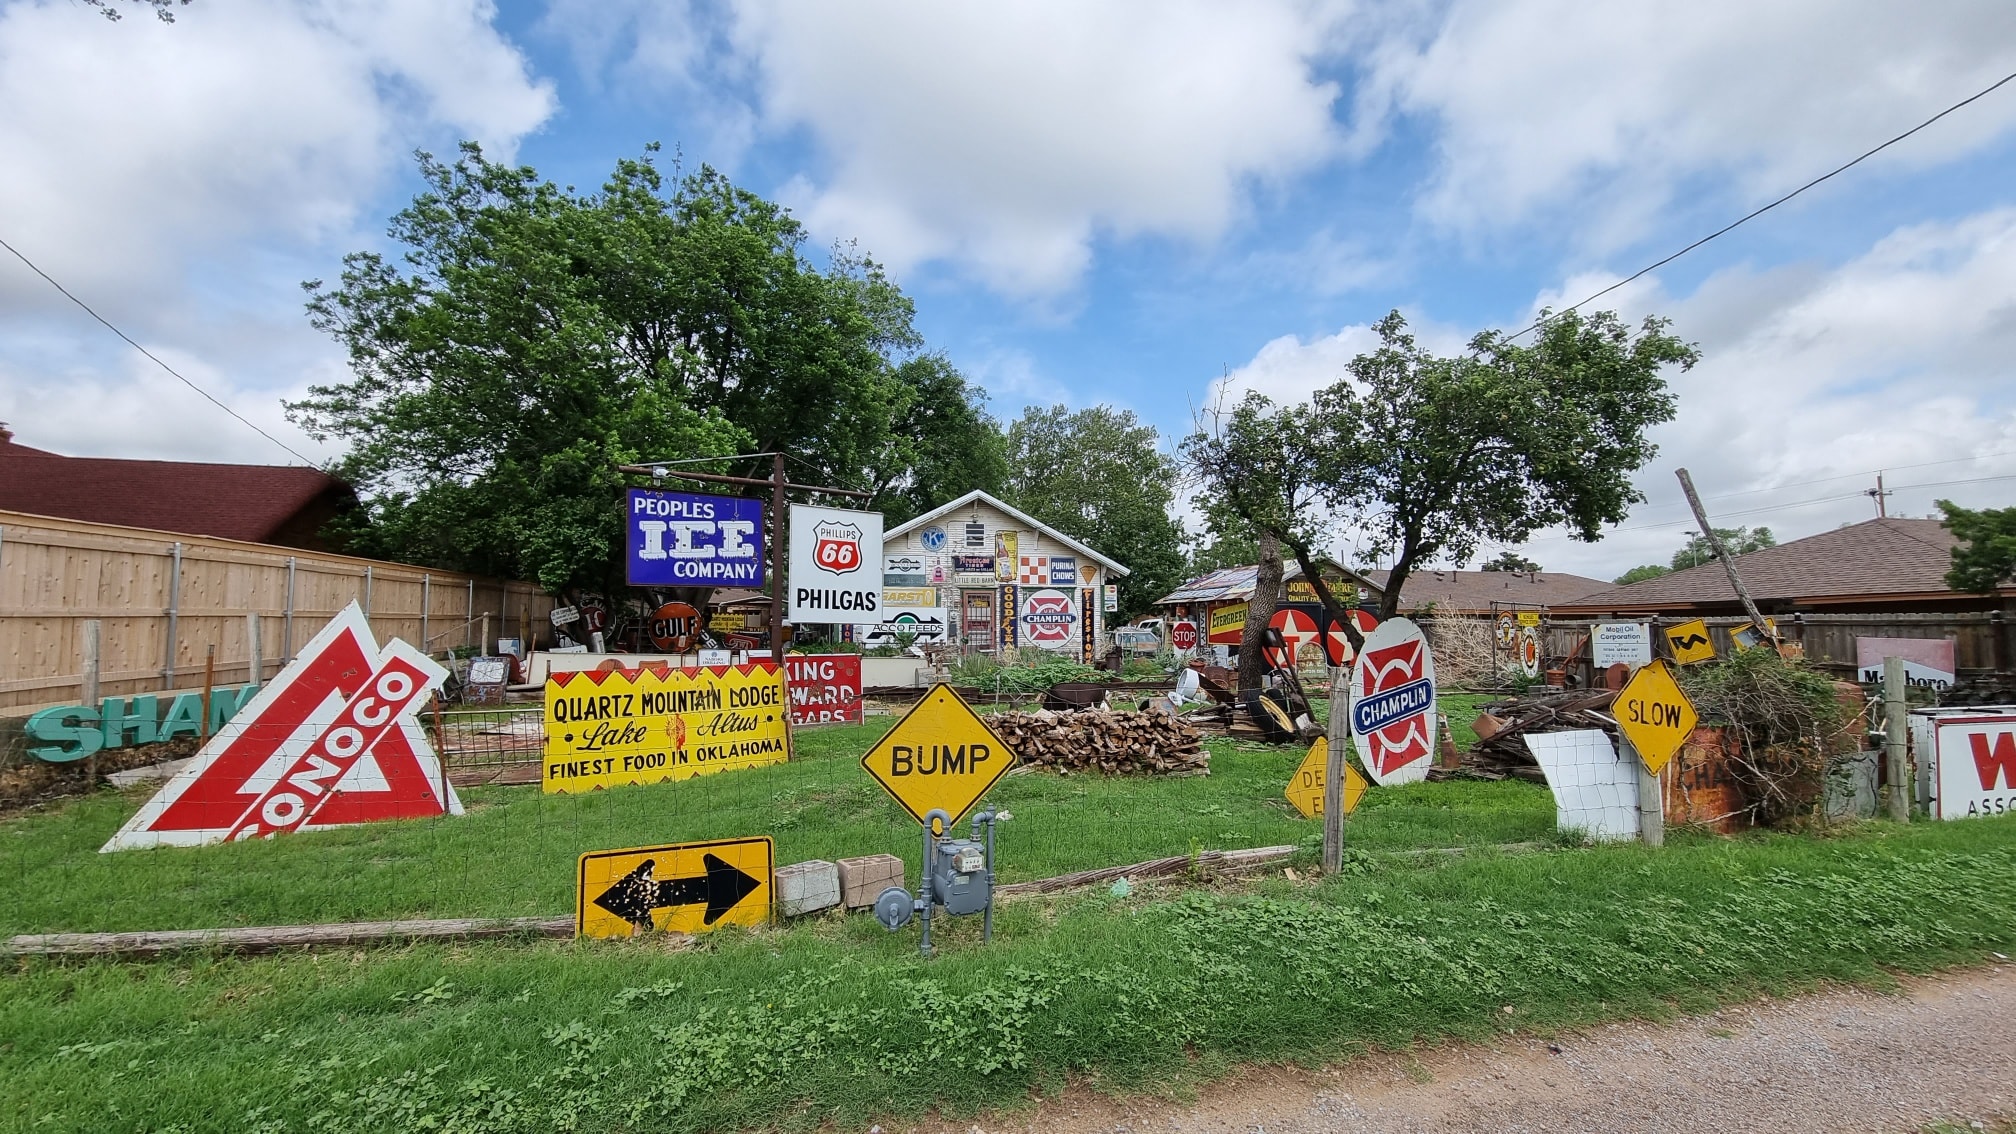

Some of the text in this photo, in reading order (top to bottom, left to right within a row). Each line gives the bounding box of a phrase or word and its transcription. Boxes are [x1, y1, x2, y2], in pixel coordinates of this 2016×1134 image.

[634, 497, 715, 519] PEOPLES
[639, 520, 755, 560] ICE
[820, 528, 856, 540] PHILLIPS
[821, 543, 854, 564] 66
[673, 561, 758, 579] COMPANY
[1051, 562, 1075, 570] PURINA
[1052, 572, 1075, 580] CHOWS
[796, 588, 877, 612] PHILGAS
[653, 616, 698, 639] GULF
[872, 624, 944, 632] ACCO FEEDS
[1026, 615, 1072, 623] CHAMPLIN
[1174, 631, 1196, 642] STOP
[553, 685, 780, 723] QUARTZ MOUNTAIN LODGE
[1361, 686, 1427, 726] CHAMPLIN
[1628, 699, 1682, 728] SLOW
[576, 712, 760, 751] Lake Altus
[550, 738, 784, 779] FINEST FOOD IN OKLAHOMA
[891, 744, 990, 776] BUMP
